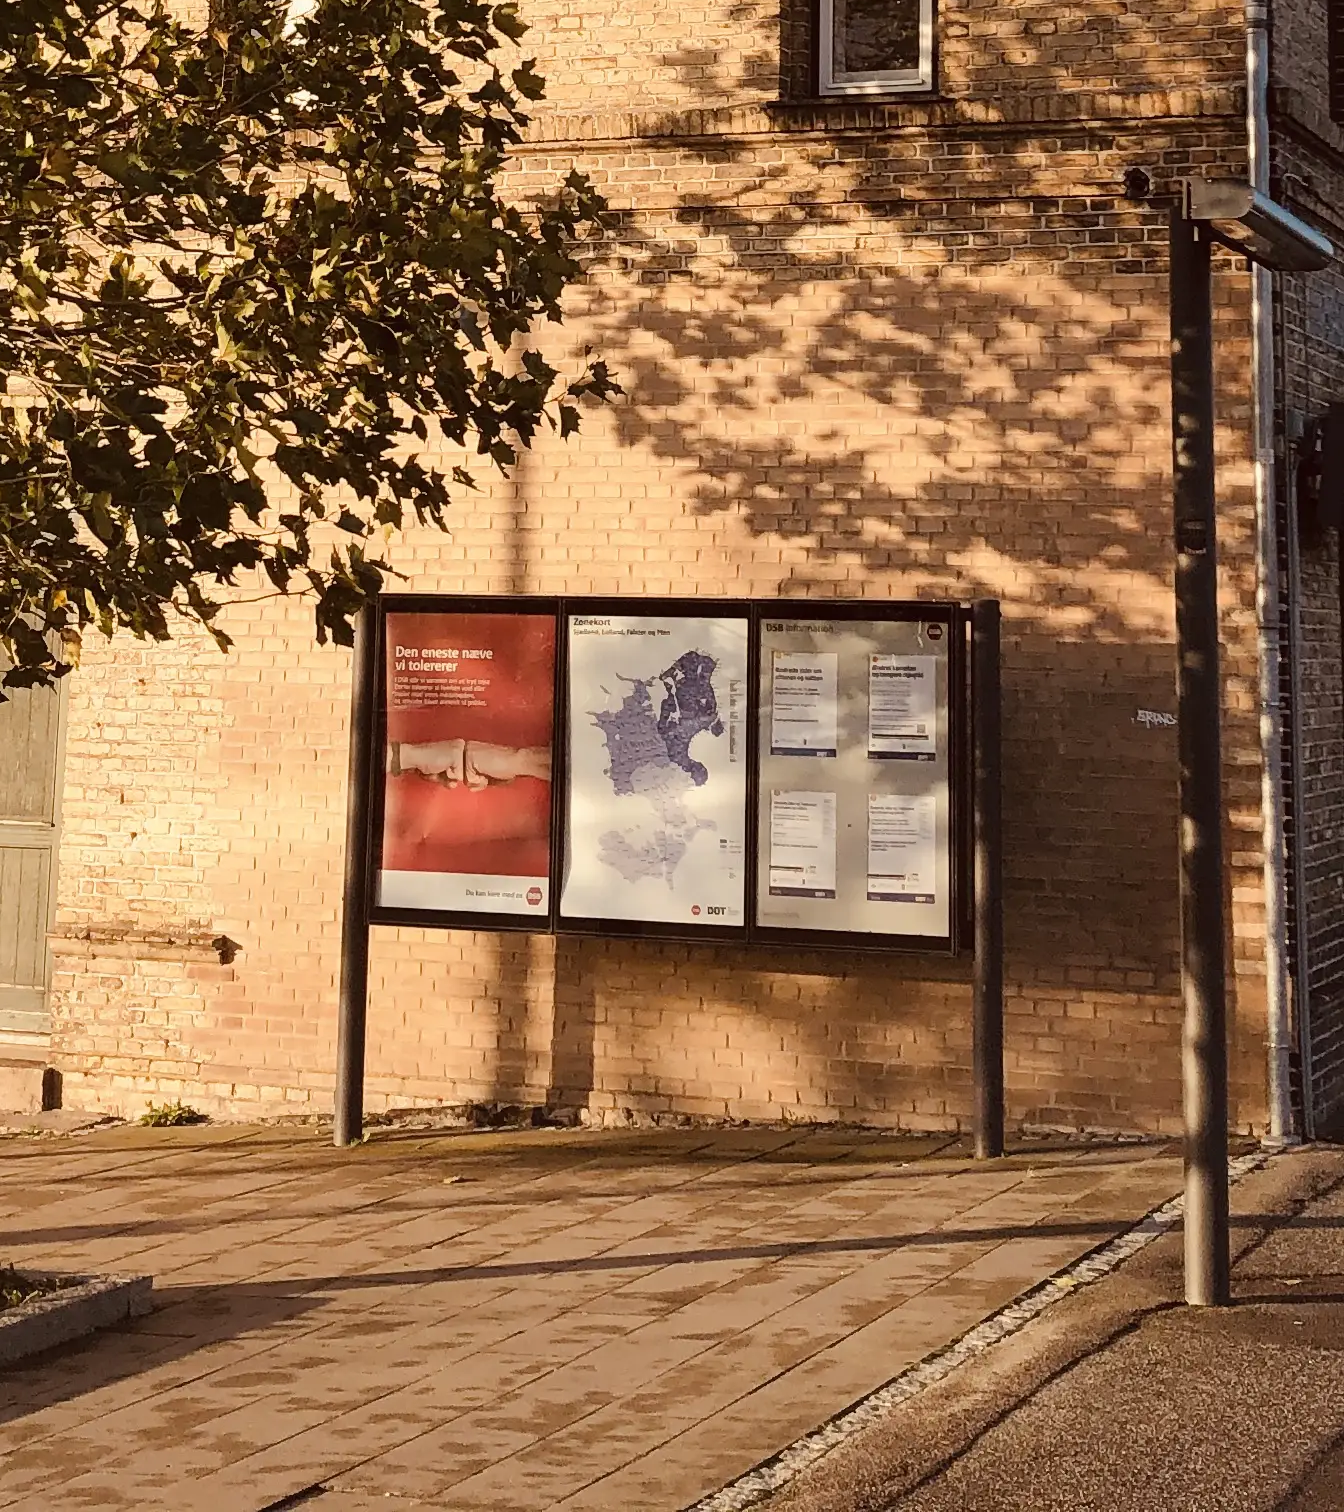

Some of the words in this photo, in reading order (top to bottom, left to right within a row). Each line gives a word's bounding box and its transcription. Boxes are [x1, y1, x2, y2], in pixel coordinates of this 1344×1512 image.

[573, 617, 611, 626] Zonekort
[766, 623, 784, 632] DSB
[395, 645, 419, 658] Den
[421, 647, 460, 659] eneste
[462, 649, 494, 660] næve
[395, 658, 406, 671] vi
[408, 659, 459, 672] tolererer
[707, 906, 727, 916] DOT
